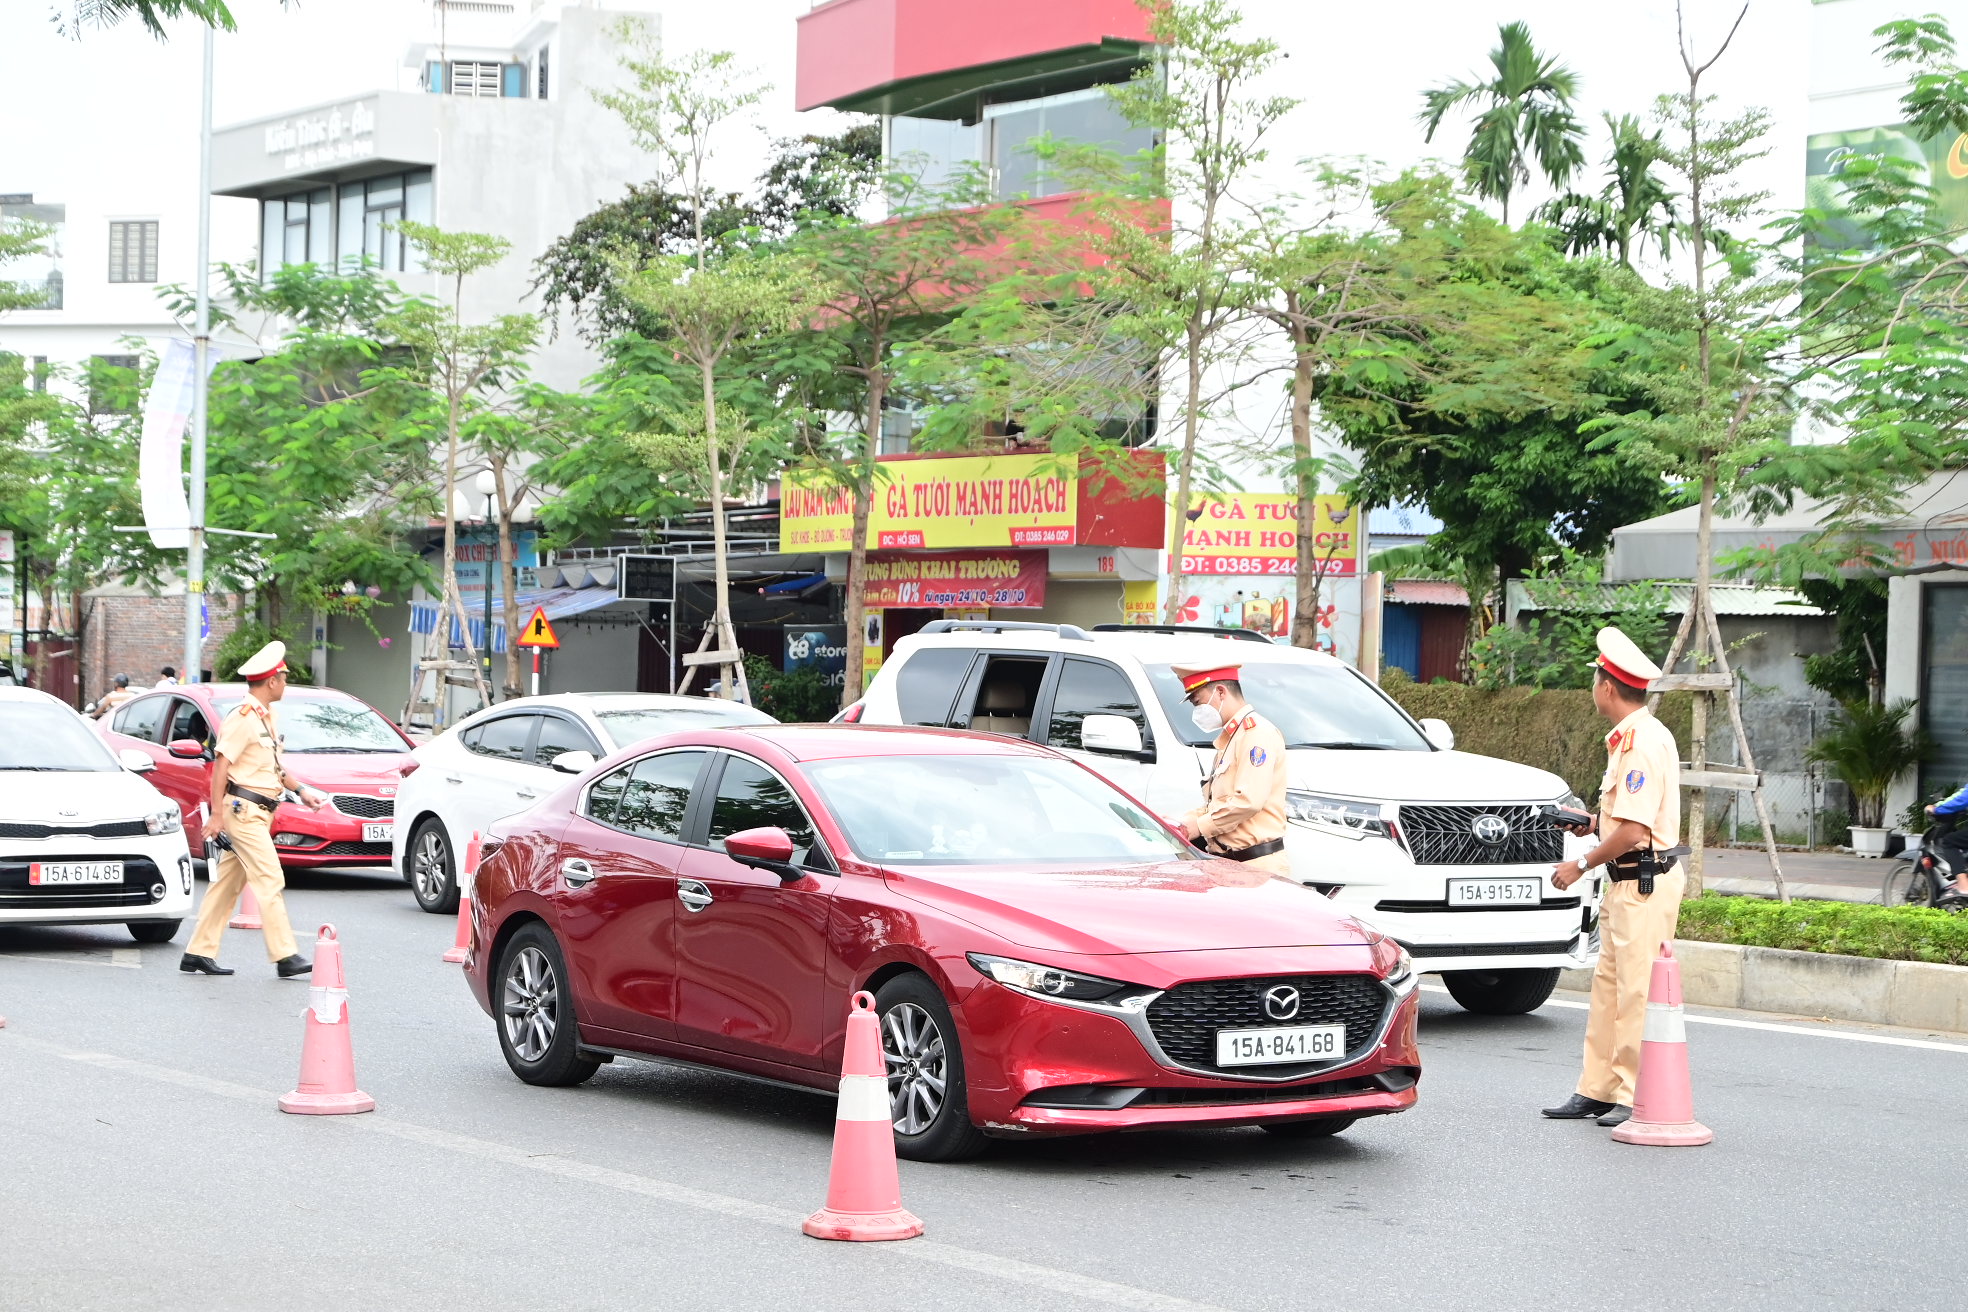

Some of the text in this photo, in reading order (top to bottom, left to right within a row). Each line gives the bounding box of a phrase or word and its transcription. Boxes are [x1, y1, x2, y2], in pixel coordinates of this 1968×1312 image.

[887, 473, 908, 518] GÀ
[913, 475, 951, 518] TƯƠI
[955, 479, 1003, 526] MẠNH
[1008, 476, 1067, 524] HOẠCH
[1210, 499, 1246, 520] GÀ
[908, 534, 920, 545] SEN
[1026, 531, 1042, 542] 0385
[1043, 530, 1055, 541] 246
[1056, 529, 1069, 541] 029
[1260, 531, 1349, 549] HOCH
[920, 560, 955, 579] KHAI
[959, 557, 1020, 579] TRƯƠNG
[1098, 556, 1114, 573] 189
[1215, 557, 1261, 573] 0385
[898, 582, 920, 603] 10%
[958, 588, 986, 603] 24/10
[44, 865, 120, 882] 15A-614.85
[1459, 884, 1533, 900] 15A-915.72
[1231, 1033, 1334, 1058] 15A-841.68
